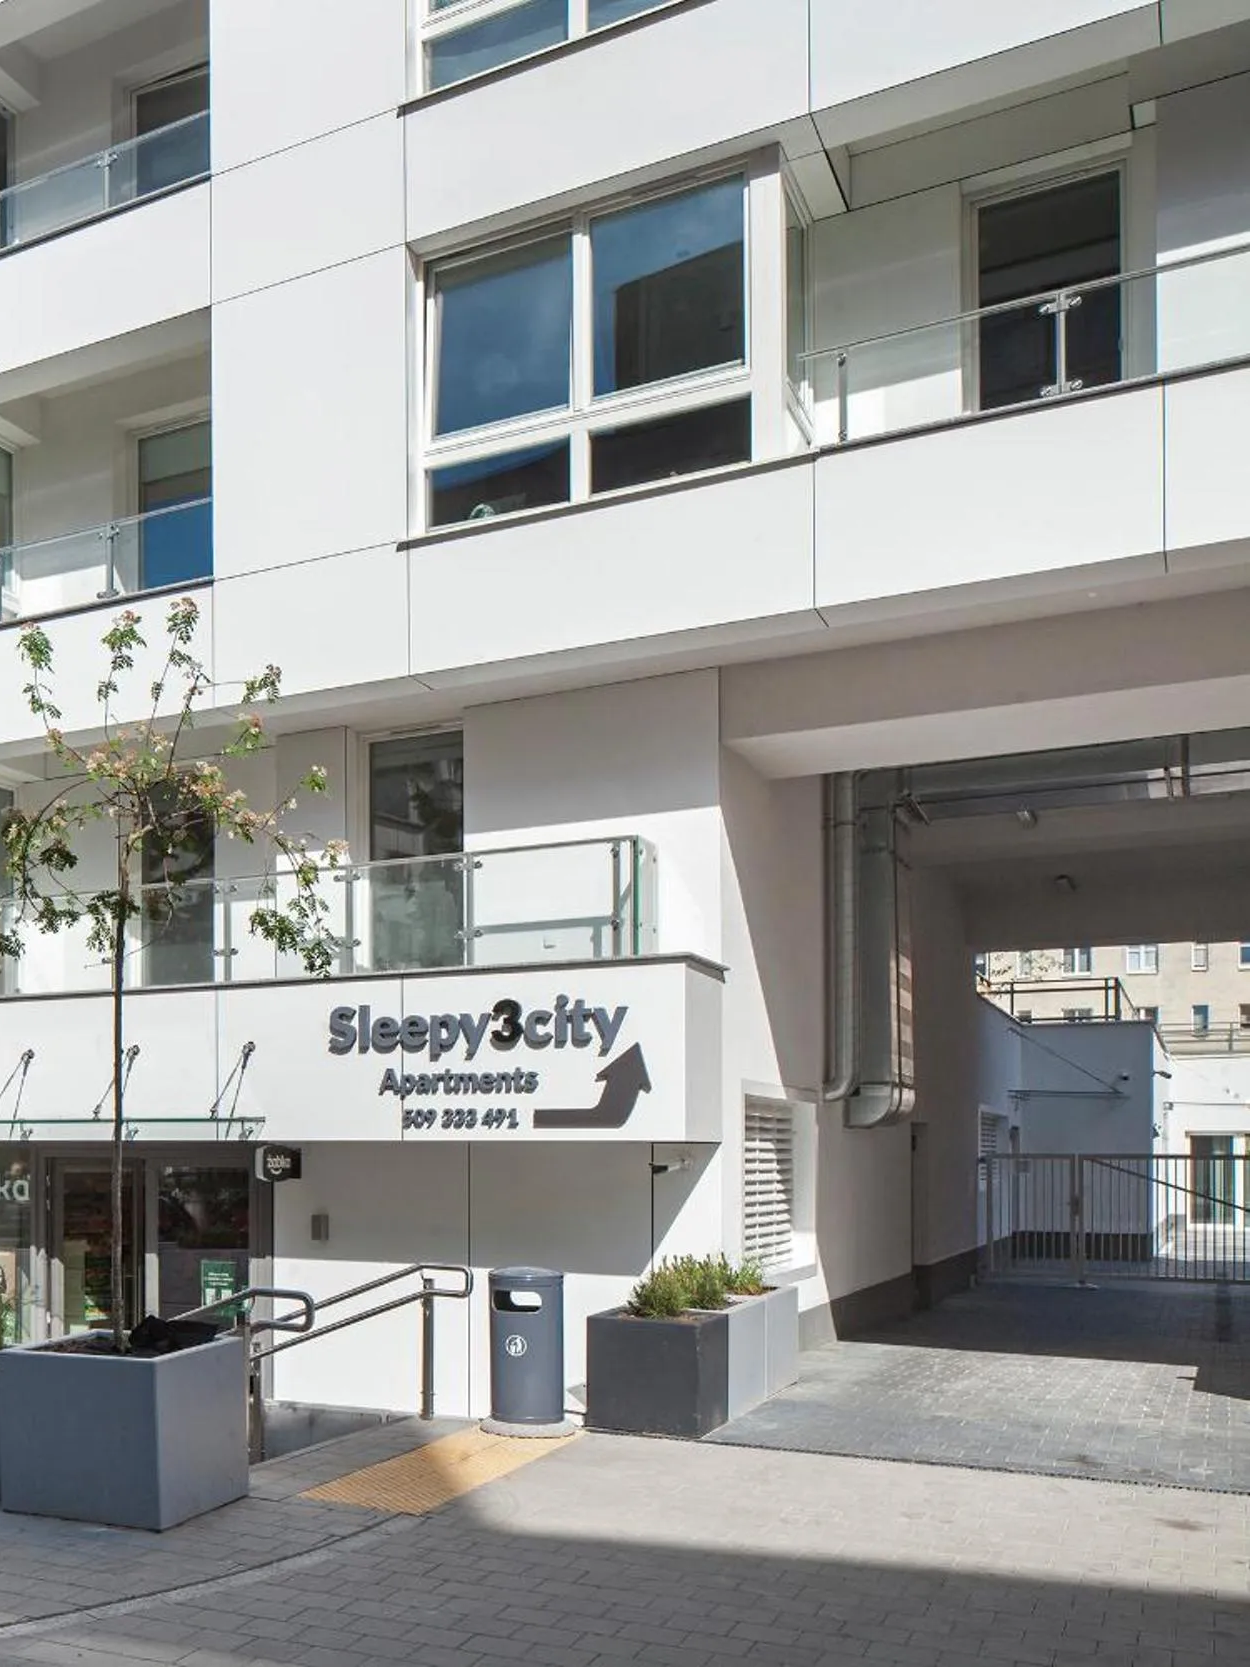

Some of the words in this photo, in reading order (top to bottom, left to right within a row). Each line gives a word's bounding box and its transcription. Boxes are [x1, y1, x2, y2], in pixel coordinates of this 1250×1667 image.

[328, 994, 628, 1062] Sleepy3city
[378, 1067, 540, 1100] Apartments
[401, 1108, 437, 1130] 509
[441, 1108, 477, 1130] 333
[481, 1108, 519, 1130] 491
